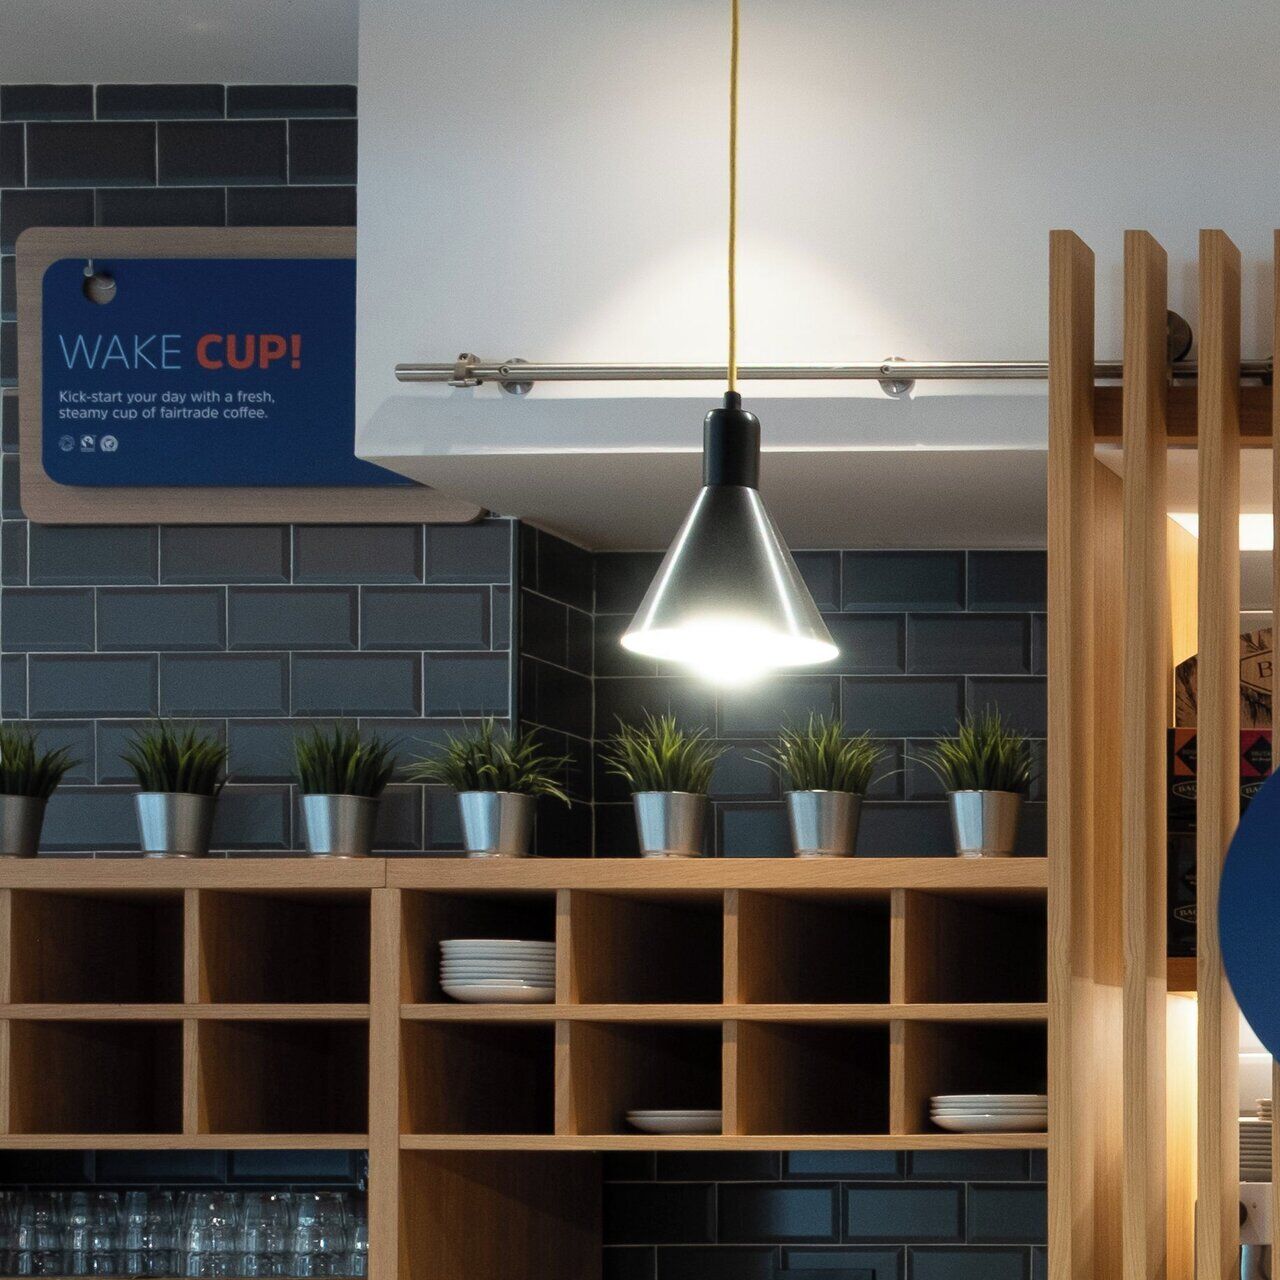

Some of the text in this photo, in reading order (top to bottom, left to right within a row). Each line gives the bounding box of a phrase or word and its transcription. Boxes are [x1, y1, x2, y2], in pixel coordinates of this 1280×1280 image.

[59, 333, 302, 370] WAKE CUP!
[59, 391, 276, 405] Kick-start your day with a fresh,
[59, 406, 268, 420] steamy cup of fairtrade coffee.
